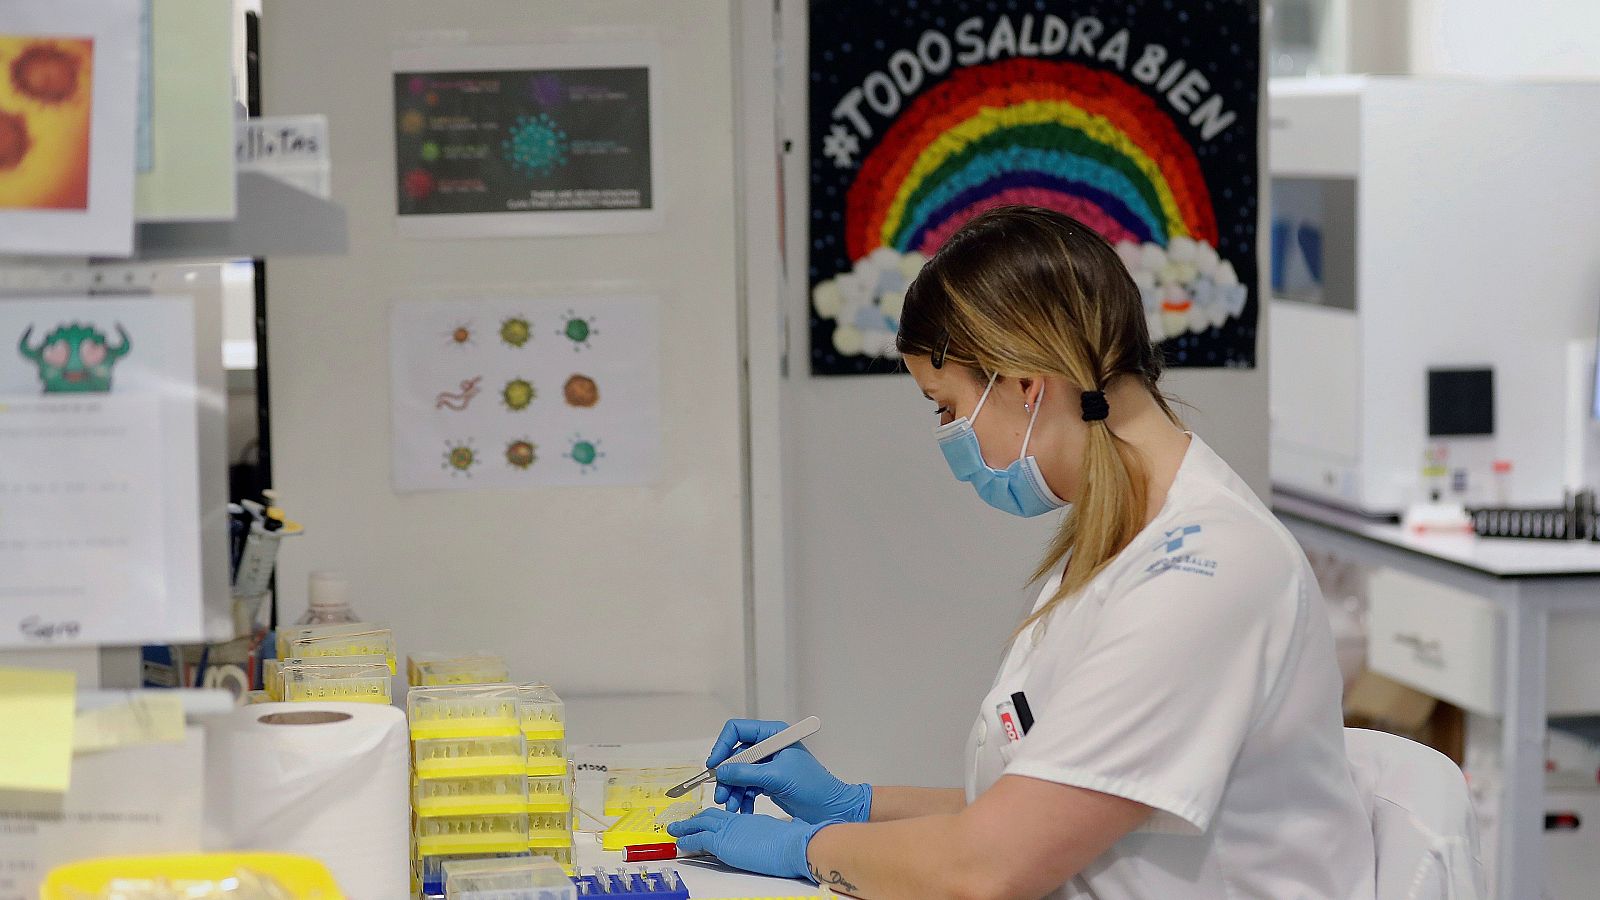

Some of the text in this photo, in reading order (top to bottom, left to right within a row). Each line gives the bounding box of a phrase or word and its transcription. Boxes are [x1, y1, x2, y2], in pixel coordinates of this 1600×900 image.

[824, 14, 1236, 168] #TODO SALDRA BIEN
